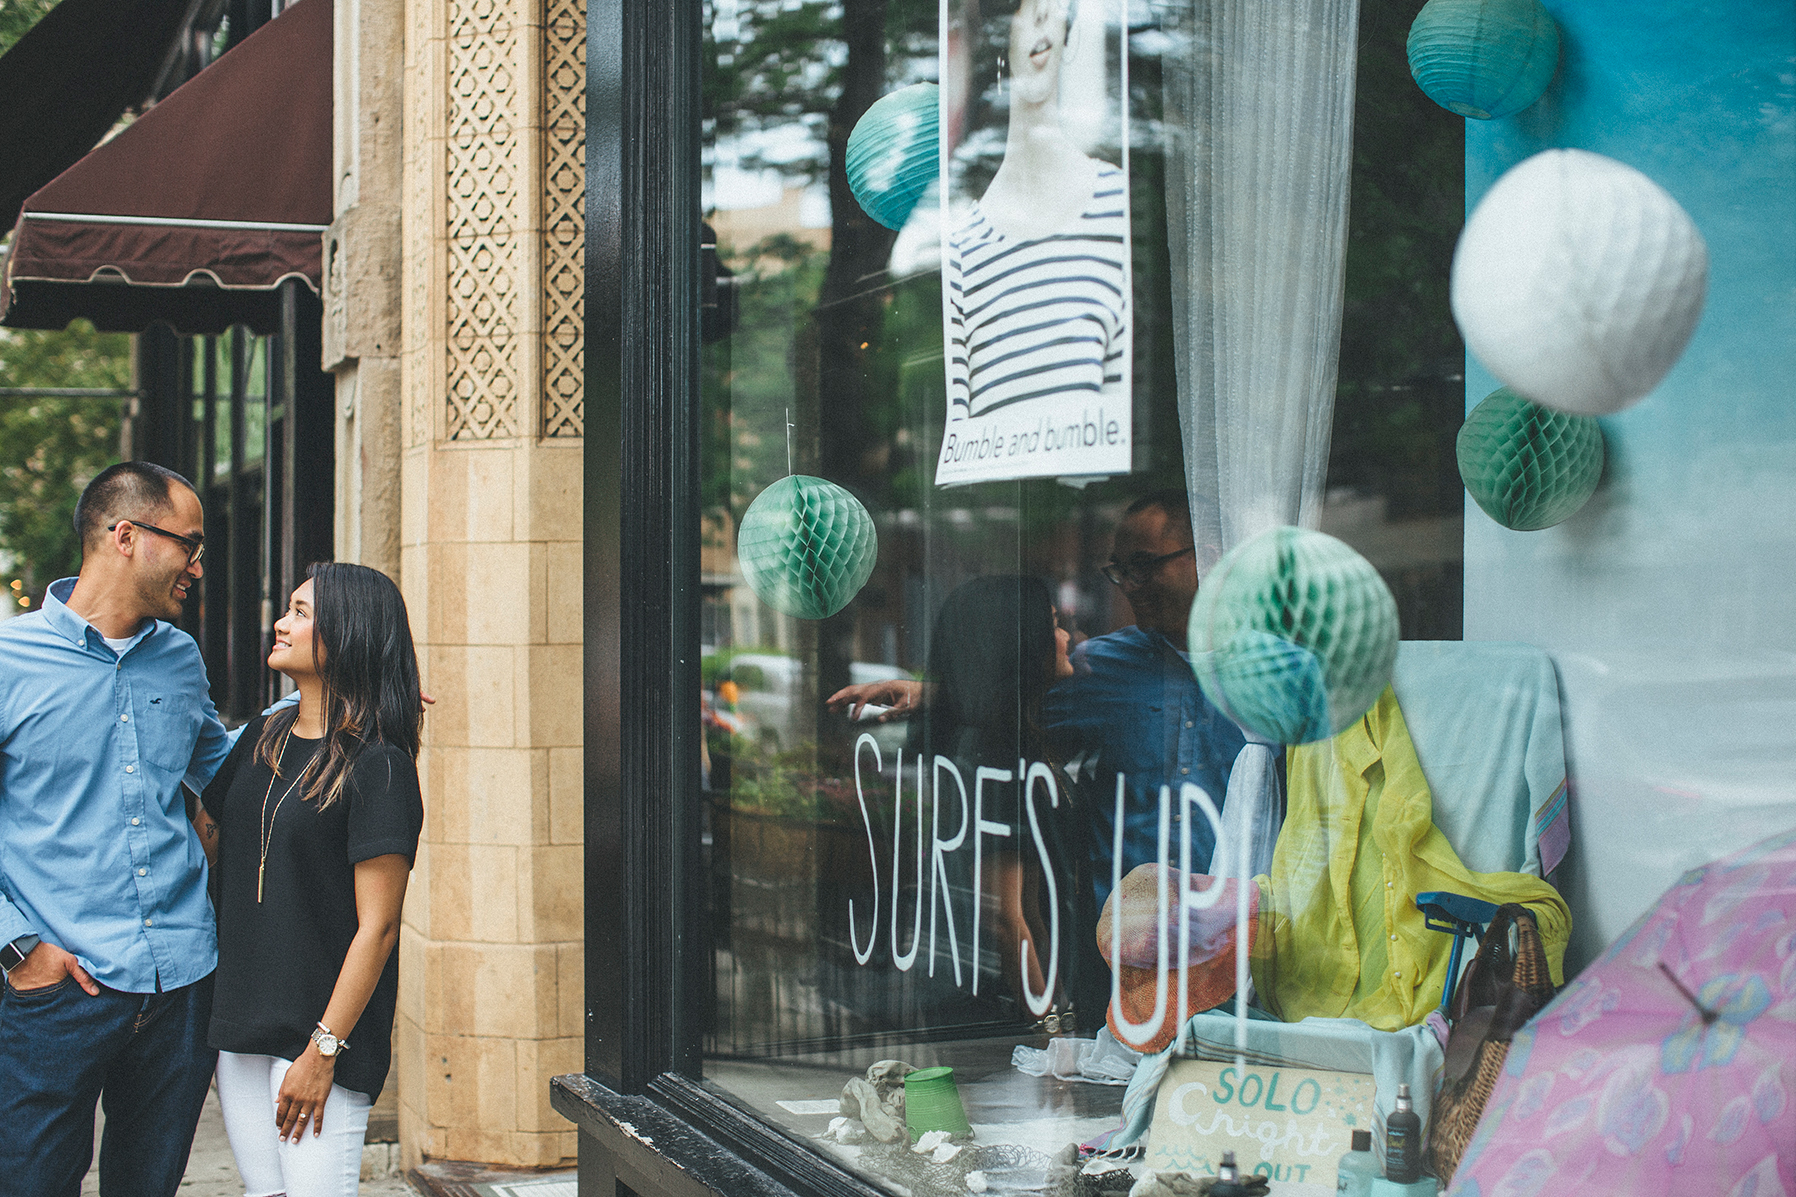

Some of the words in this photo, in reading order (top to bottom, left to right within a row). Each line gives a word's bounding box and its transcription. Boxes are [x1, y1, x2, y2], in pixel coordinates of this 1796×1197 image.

[944, 425, 1004, 464] Bumble
[1008, 417, 1043, 457] and
[1045, 408, 1127, 453] bumble.
[849, 732, 1059, 1017] SURF'S
[1212, 1067, 1322, 1115] SOLO
[1195, 1108, 1340, 1161] night
[1253, 1161, 1312, 1183] OUT
